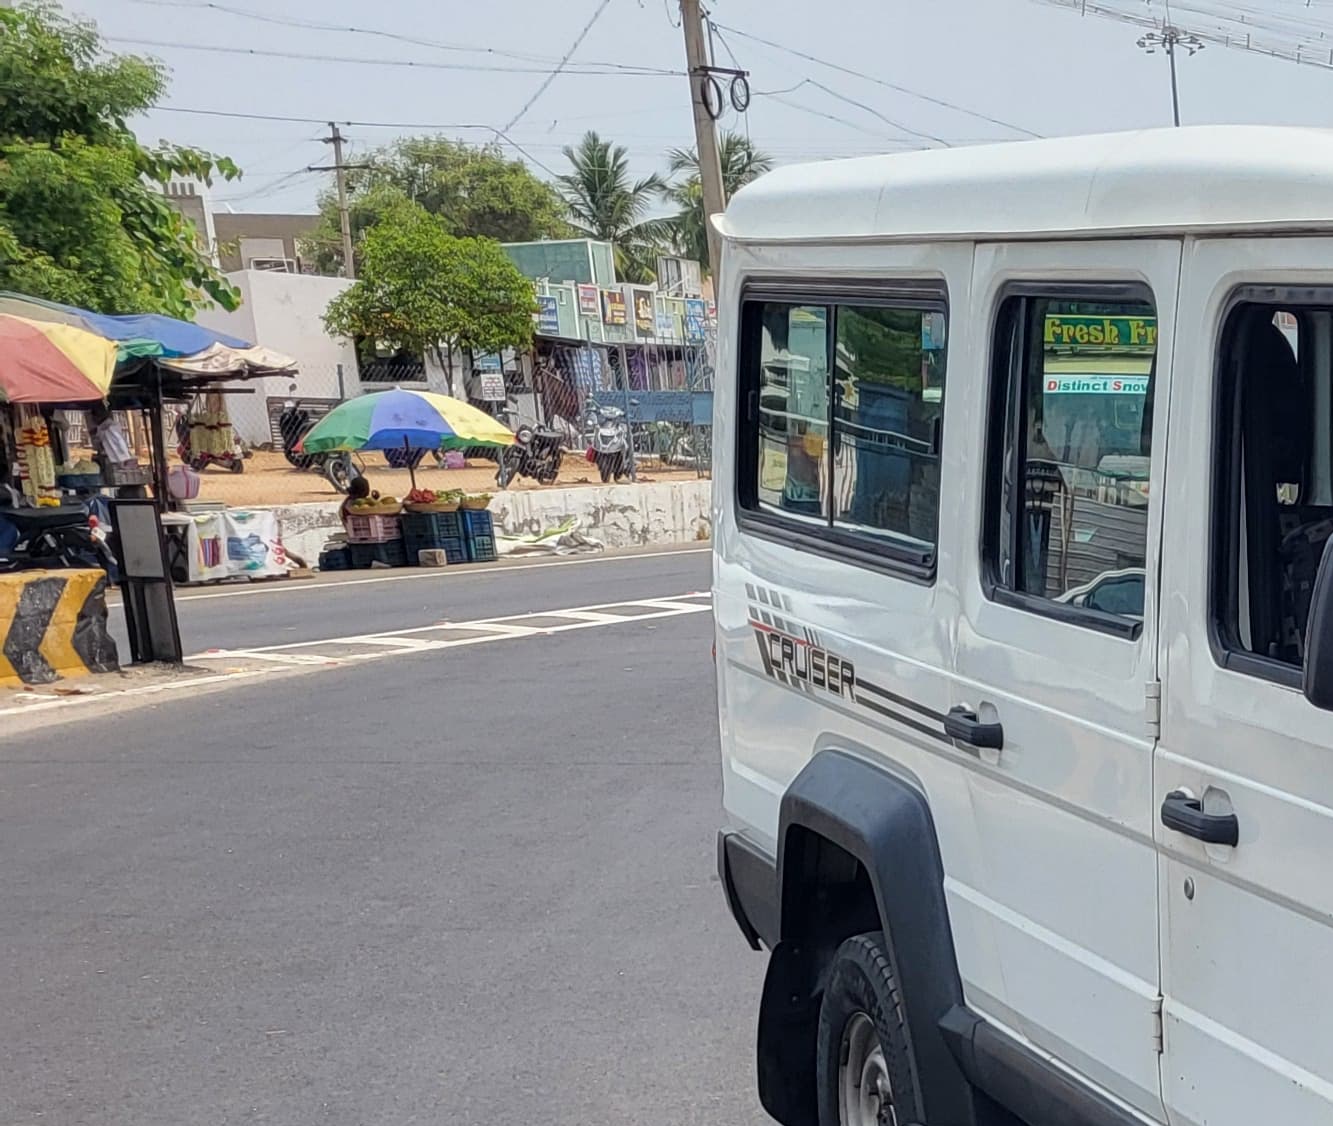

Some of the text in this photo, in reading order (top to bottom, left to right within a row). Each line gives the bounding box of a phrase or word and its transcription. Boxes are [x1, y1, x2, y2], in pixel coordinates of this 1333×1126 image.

[1044, 318, 1119, 344] Fresh
[1047, 380, 1108, 391] Distinct
[770, 631, 856, 703] CRUISER
